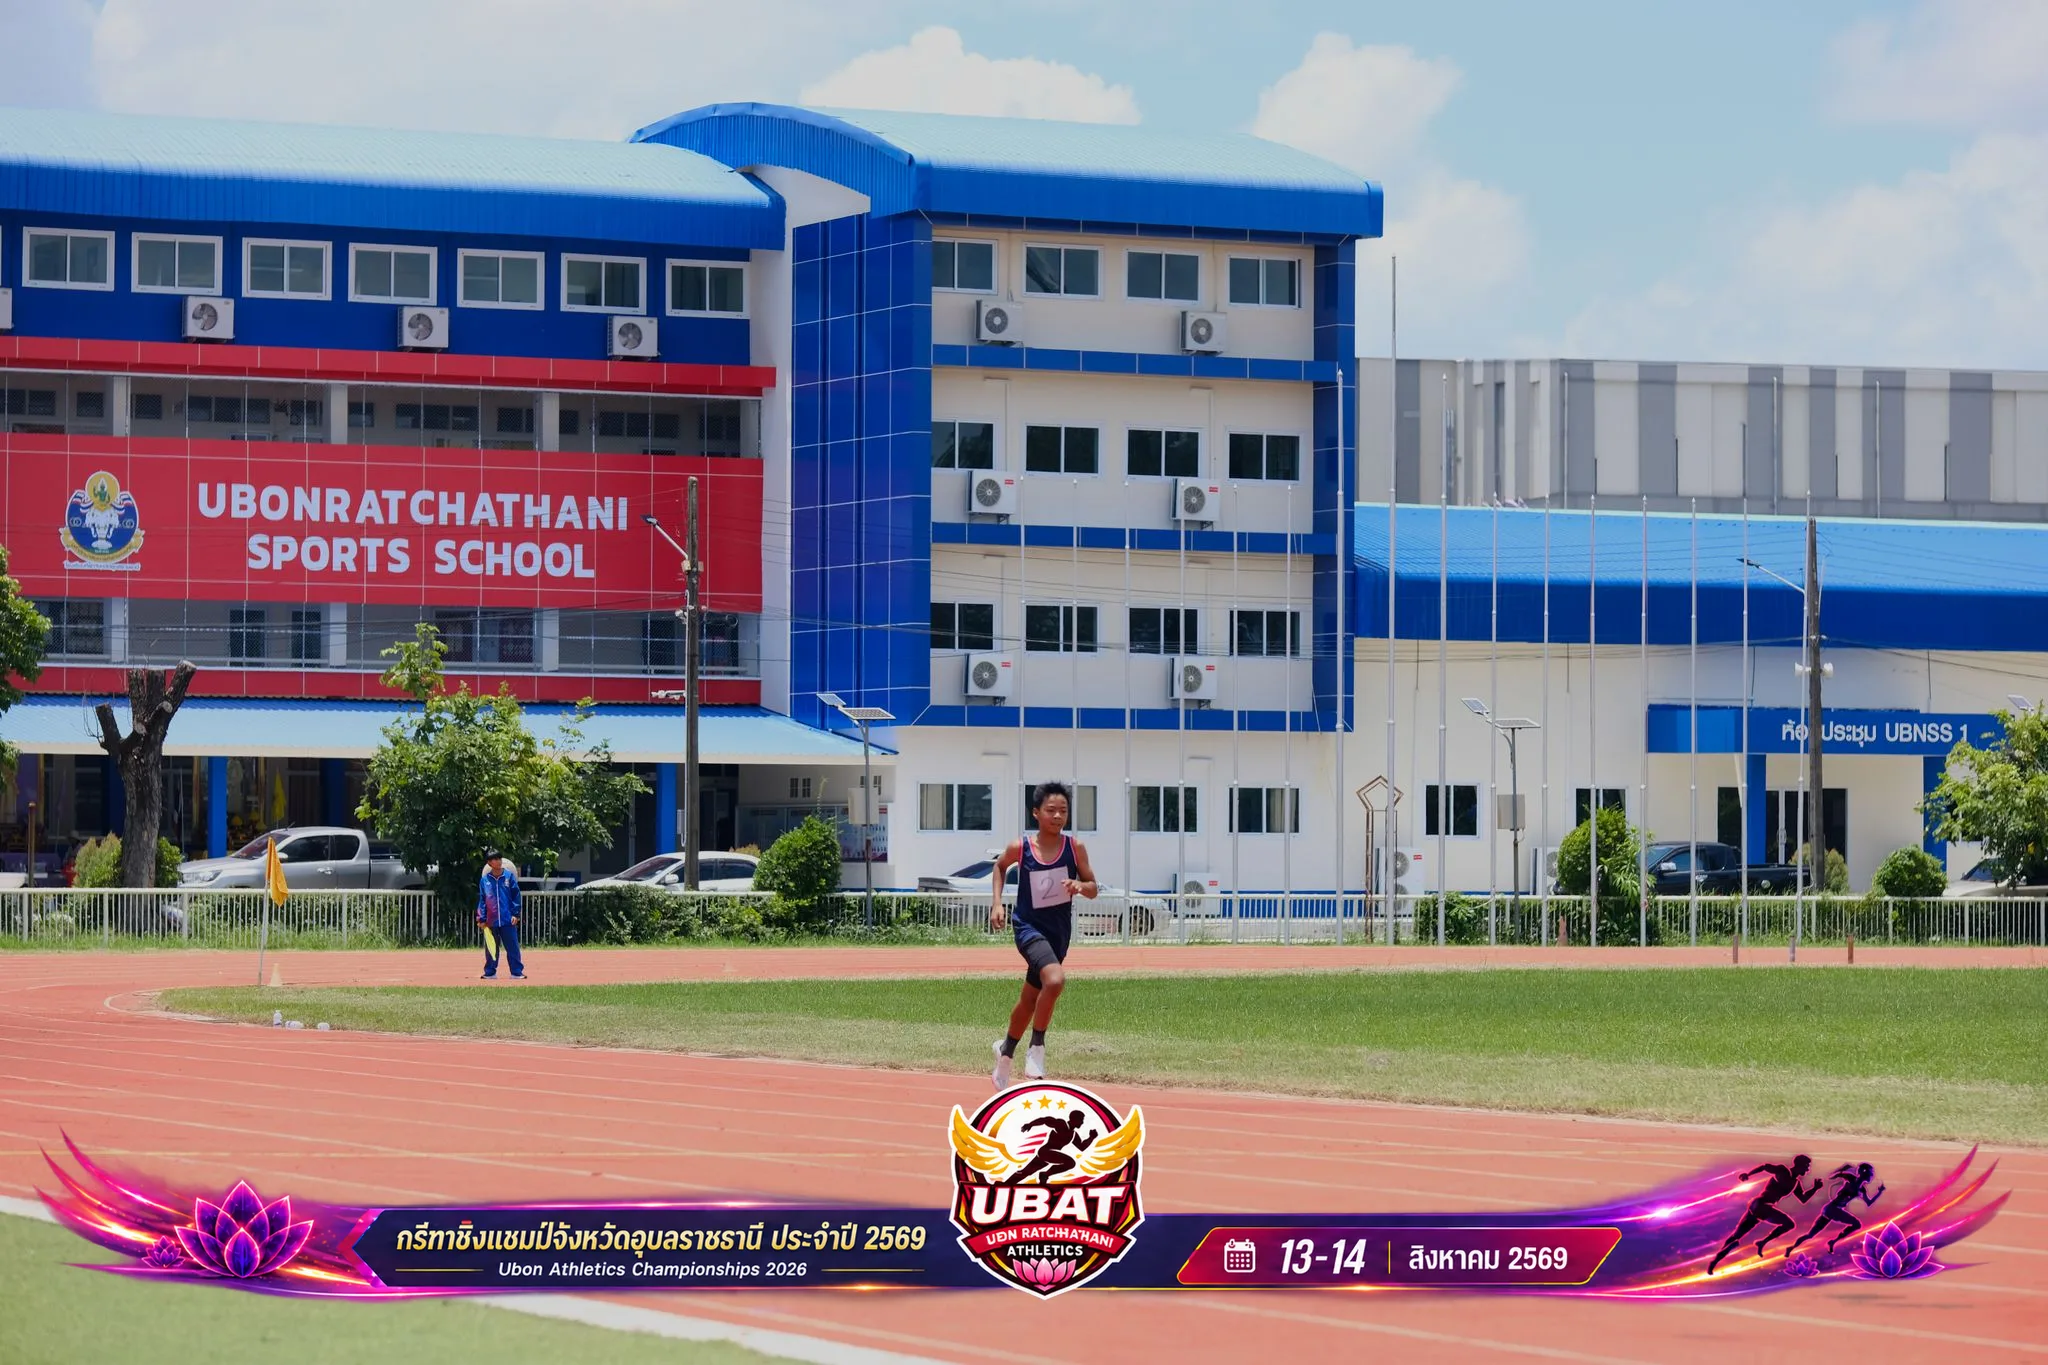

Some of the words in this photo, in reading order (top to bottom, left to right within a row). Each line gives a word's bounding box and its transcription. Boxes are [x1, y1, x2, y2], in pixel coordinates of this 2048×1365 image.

[198, 483, 628, 530] UBONRATCHATHANI
[248, 534, 410, 573] SPORTS
[434, 539, 595, 578] SCHOOL
[1782, 719, 1877, 748] ห้อประชุม
[1885, 722, 1953, 743] UBNSS
[1960, 724, 1968, 743] 1
[1041, 877, 1059, 900] 2
